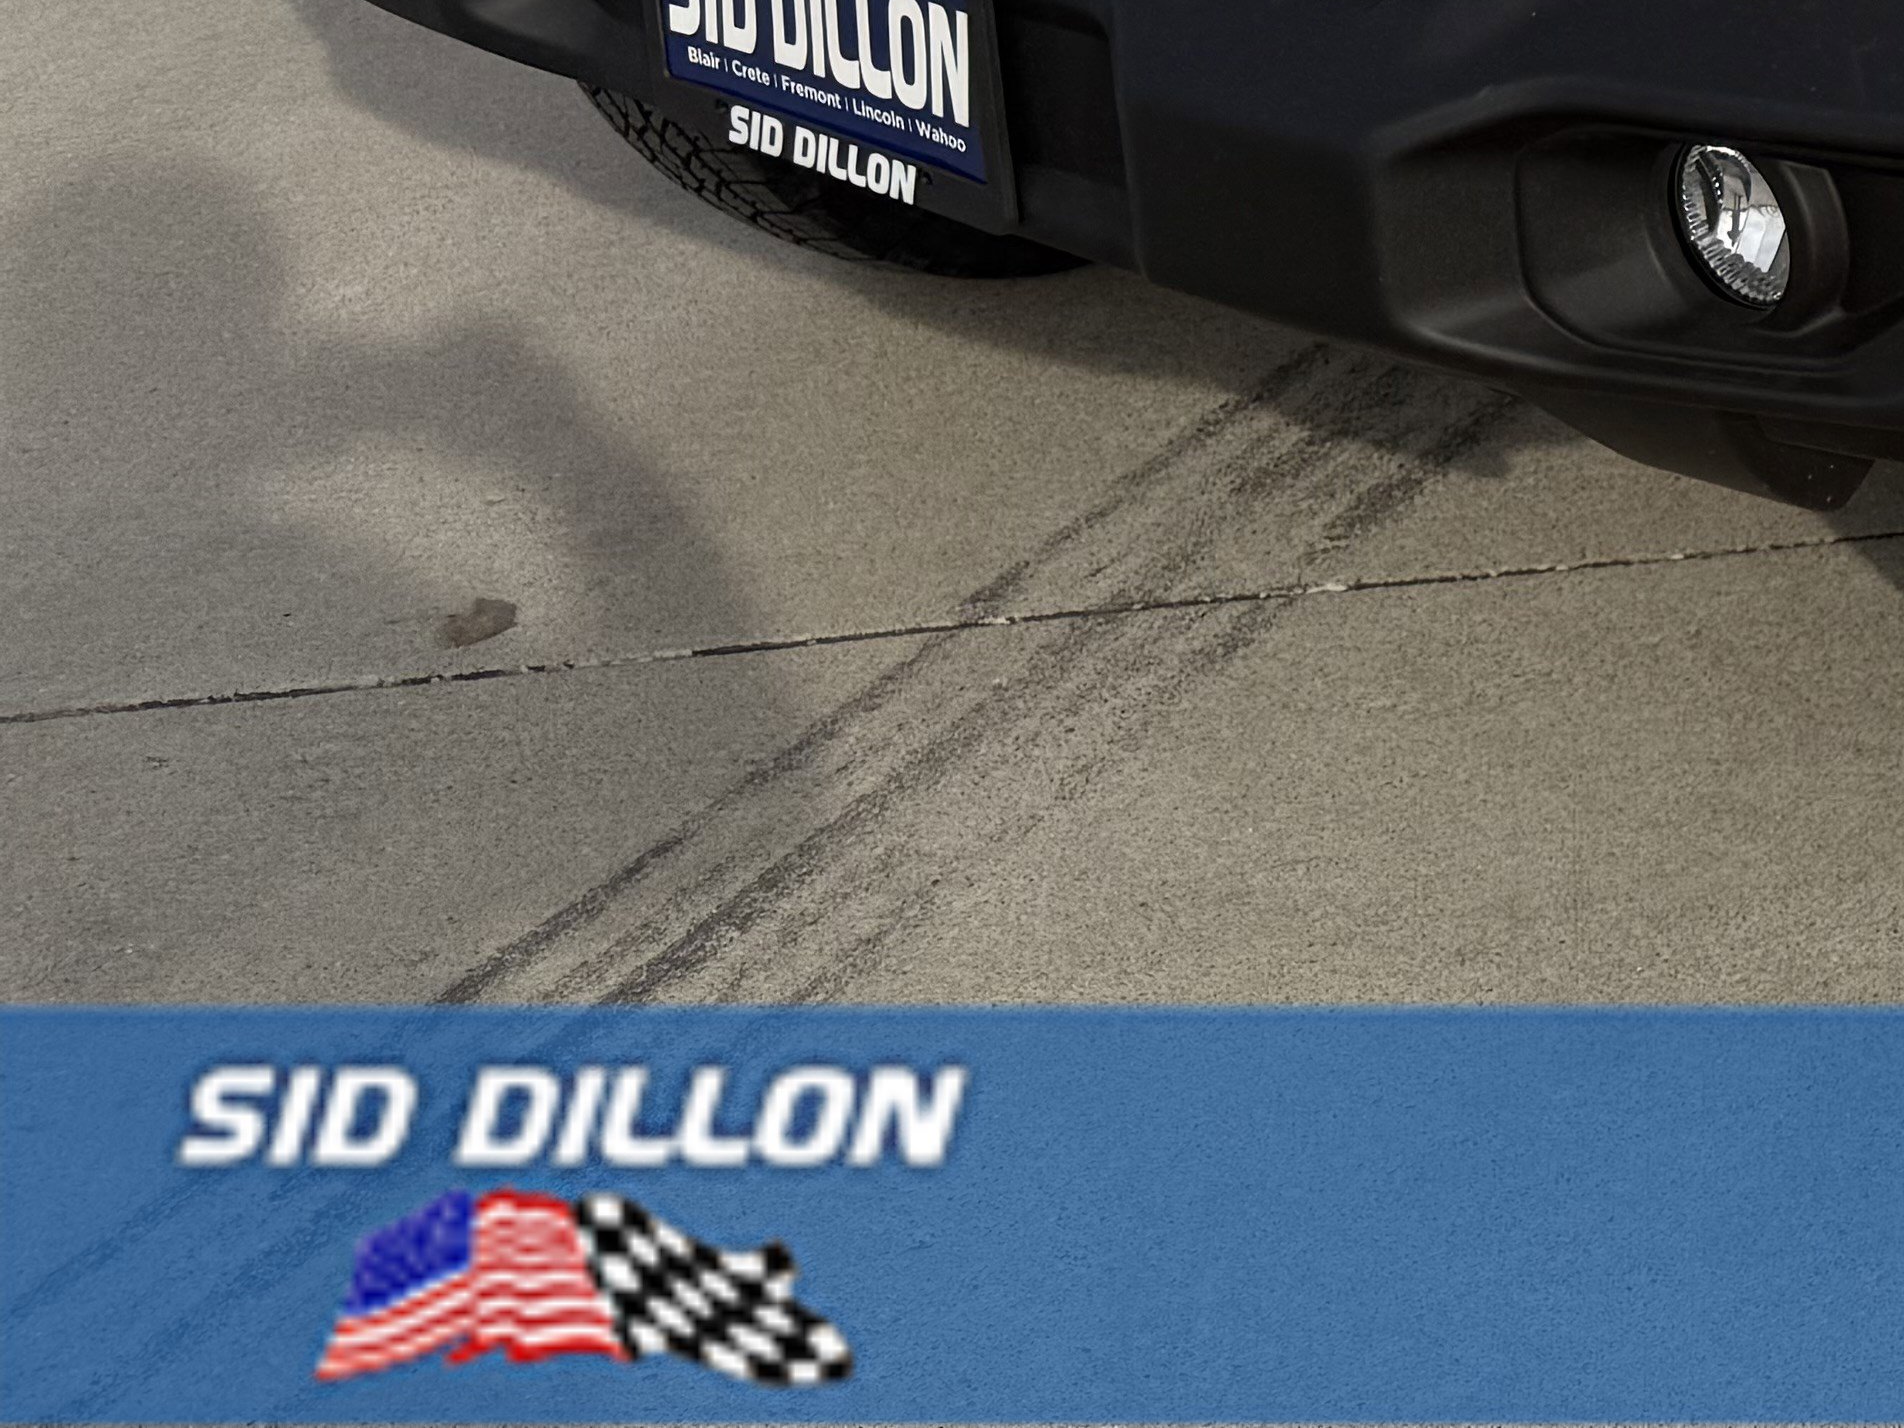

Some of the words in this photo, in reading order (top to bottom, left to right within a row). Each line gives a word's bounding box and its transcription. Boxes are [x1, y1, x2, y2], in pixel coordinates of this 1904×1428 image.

[687, 45, 721, 70] Blair
[731, 58, 771, 87] Crete
[780, 74, 843, 111] Fremont
[852, 96, 905, 131] Lincoln
[914, 117, 967, 154] Wahoo
[728, 104, 784, 157] SID
[792, 125, 917, 205] DILLON
